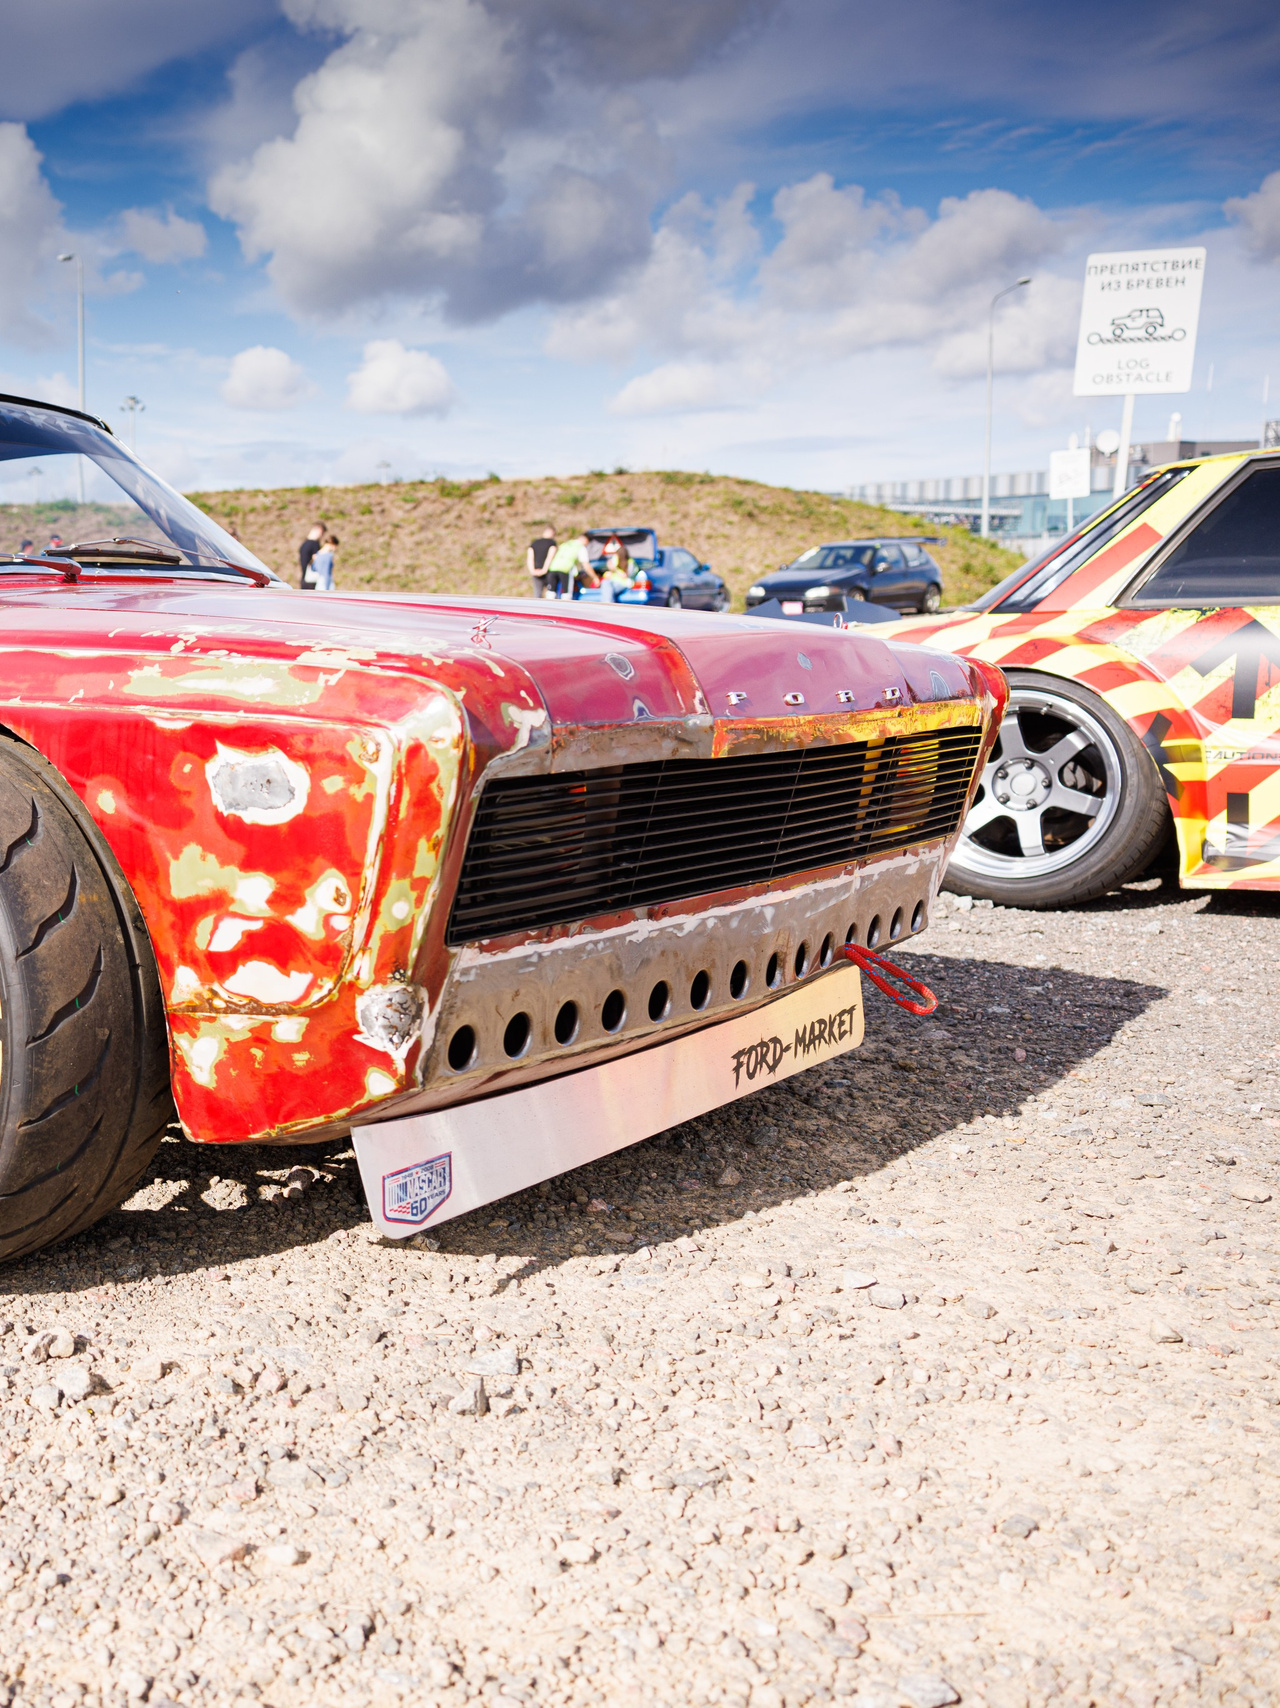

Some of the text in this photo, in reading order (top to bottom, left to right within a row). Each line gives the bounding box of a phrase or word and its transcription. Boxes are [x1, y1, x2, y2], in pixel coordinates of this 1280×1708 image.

[1086, 257, 1203, 276] ПРЕПЯТСТВИЕ
[1100, 276, 1186, 292] ИЗ БРЕВЕН
[1117, 358, 1150, 370] LOG
[1092, 371, 1173, 385] OBSTACLE
[731, 1004, 858, 1091] FORD-MARKET
[408, 1166, 447, 1200] NASCAR
[410, 1197, 428, 1217] 60
